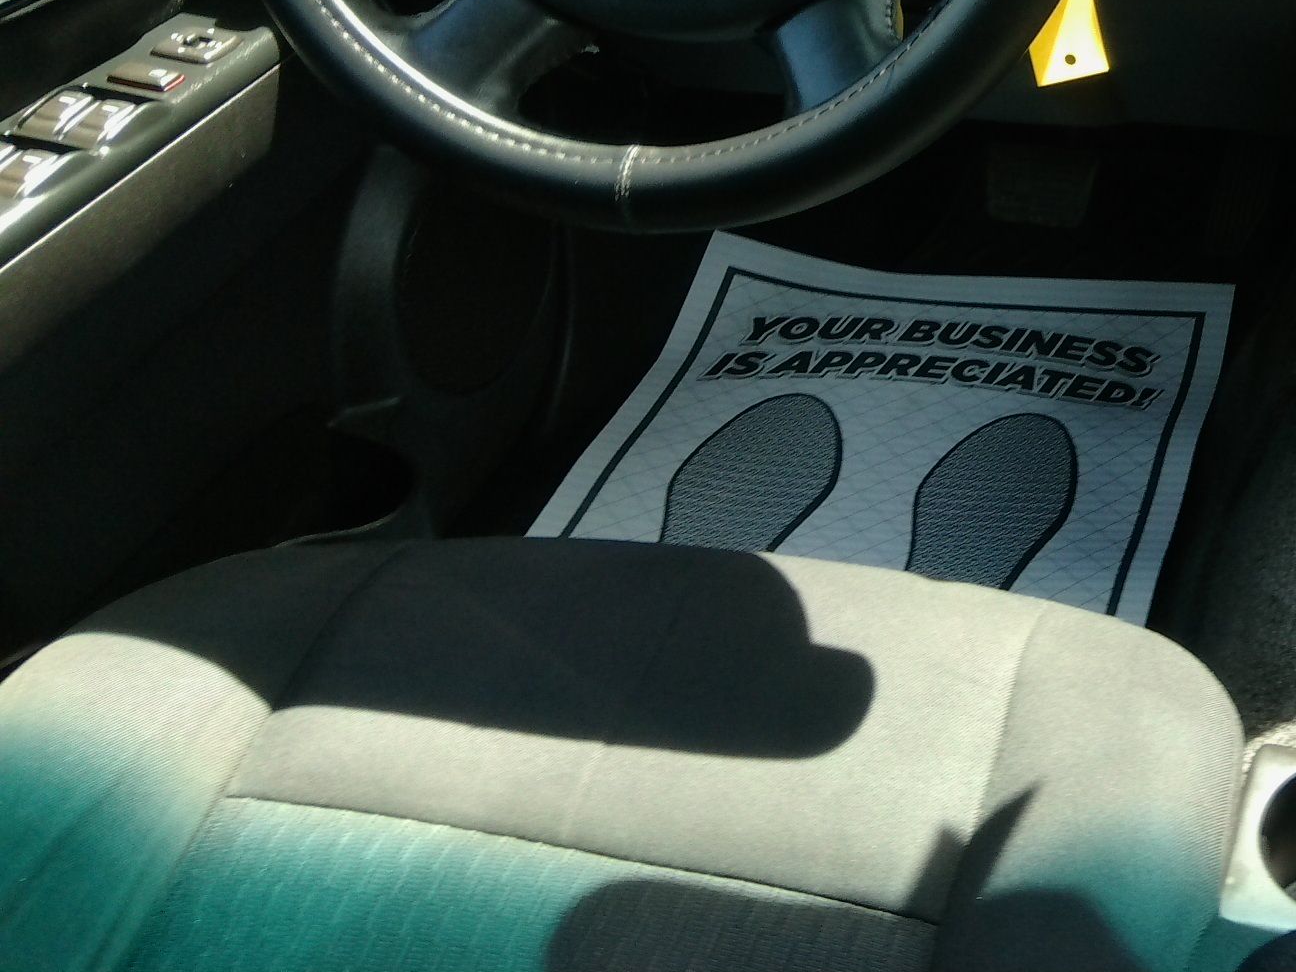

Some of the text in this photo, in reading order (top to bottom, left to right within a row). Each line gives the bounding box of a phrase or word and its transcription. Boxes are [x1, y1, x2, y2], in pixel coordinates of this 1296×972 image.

[738, 313, 1164, 378] YOUR BUSINESS
[698, 348, 1169, 411] IS APPRECIATED!
